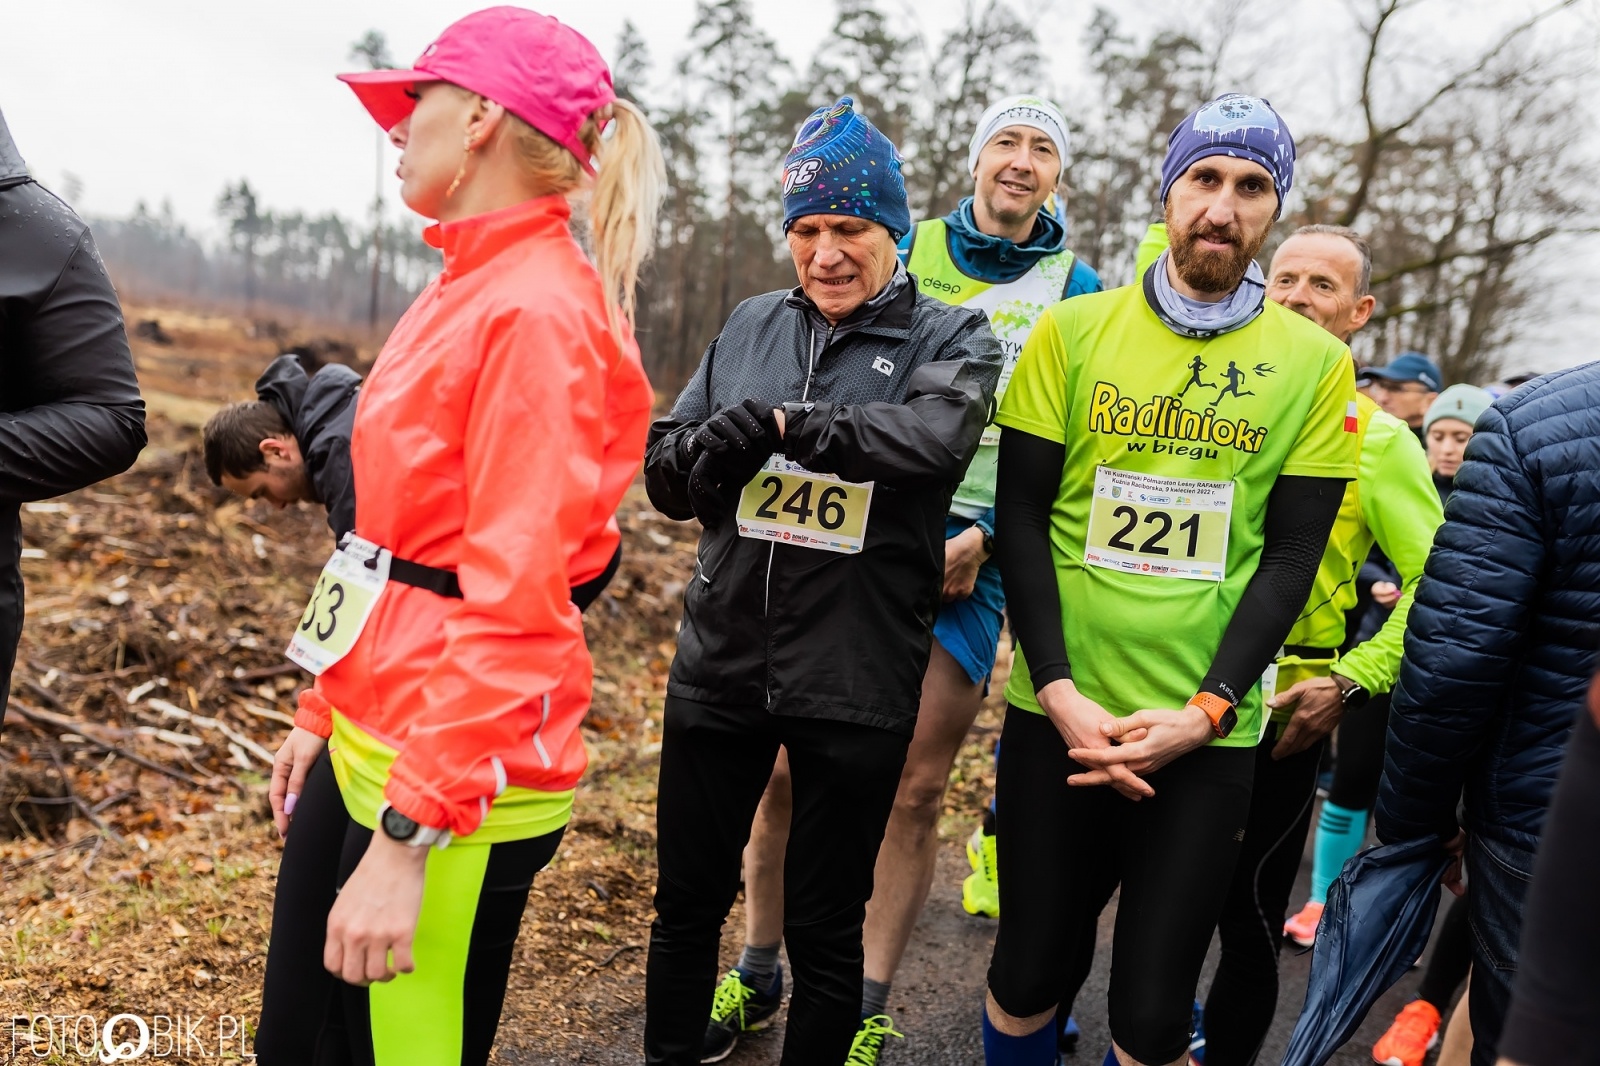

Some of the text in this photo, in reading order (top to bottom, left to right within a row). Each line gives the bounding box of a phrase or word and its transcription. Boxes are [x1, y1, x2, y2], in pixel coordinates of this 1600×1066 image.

[1009, 111, 1048, 123] LYSKI
[923, 277, 961, 294] deep
[1088, 381, 1268, 454] Radlinioki
[1126, 439, 1219, 460] w biegu
[1112, 471, 1143, 482] Kuźniański
[1178, 480, 1196, 489] Leśny
[1112, 477, 1131, 487] Kuźnia
[1131, 481, 1165, 492] Raciborska,
[755, 475, 848, 530] 246
[1108, 505, 1201, 558] 221
